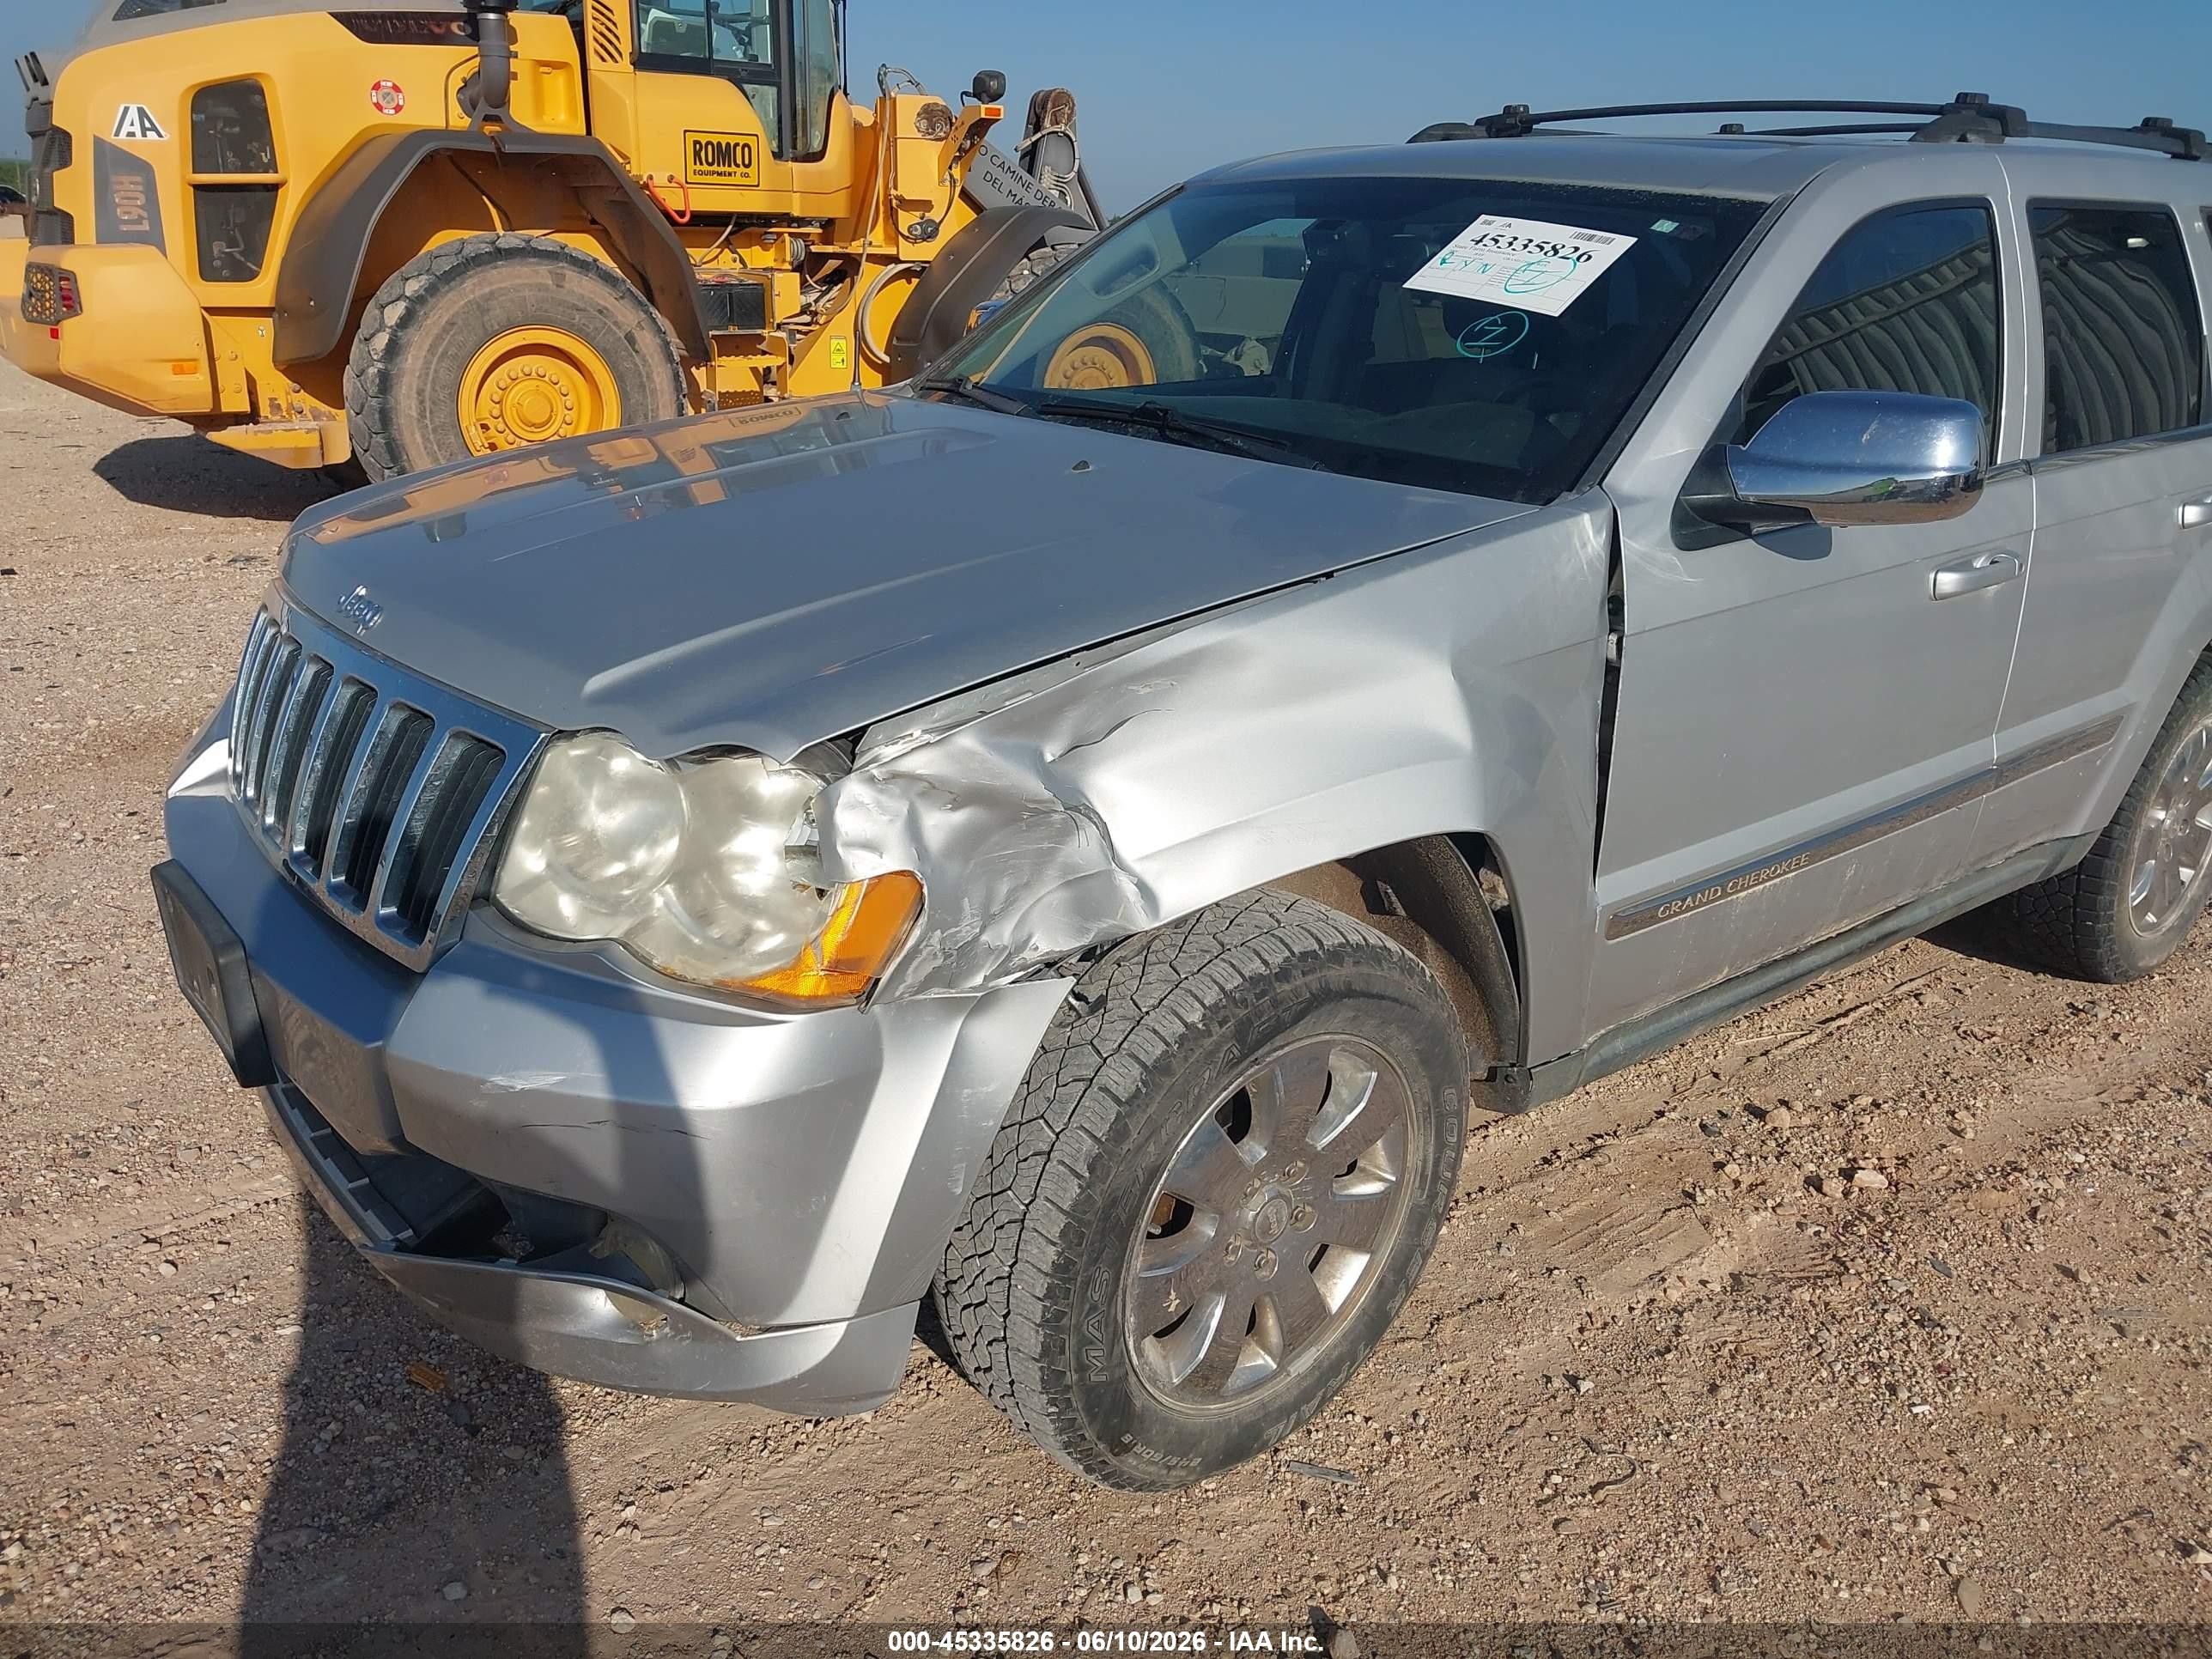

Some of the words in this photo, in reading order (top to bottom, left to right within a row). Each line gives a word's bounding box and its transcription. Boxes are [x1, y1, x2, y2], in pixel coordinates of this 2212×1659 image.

[113, 106, 165, 138] IAA
[693, 139, 752, 168] ROMCO
[694, 169, 737, 178] EQUIPMENT
[982, 170, 1004, 194] DEL
[989, 154, 1034, 194] CAMINE
[110, 174, 149, 232] L90H
[1469, 233, 1601, 264] 45335826
[1657, 885, 1722, 918] GRAND
[1726, 852, 1811, 894] CHEROKEE
